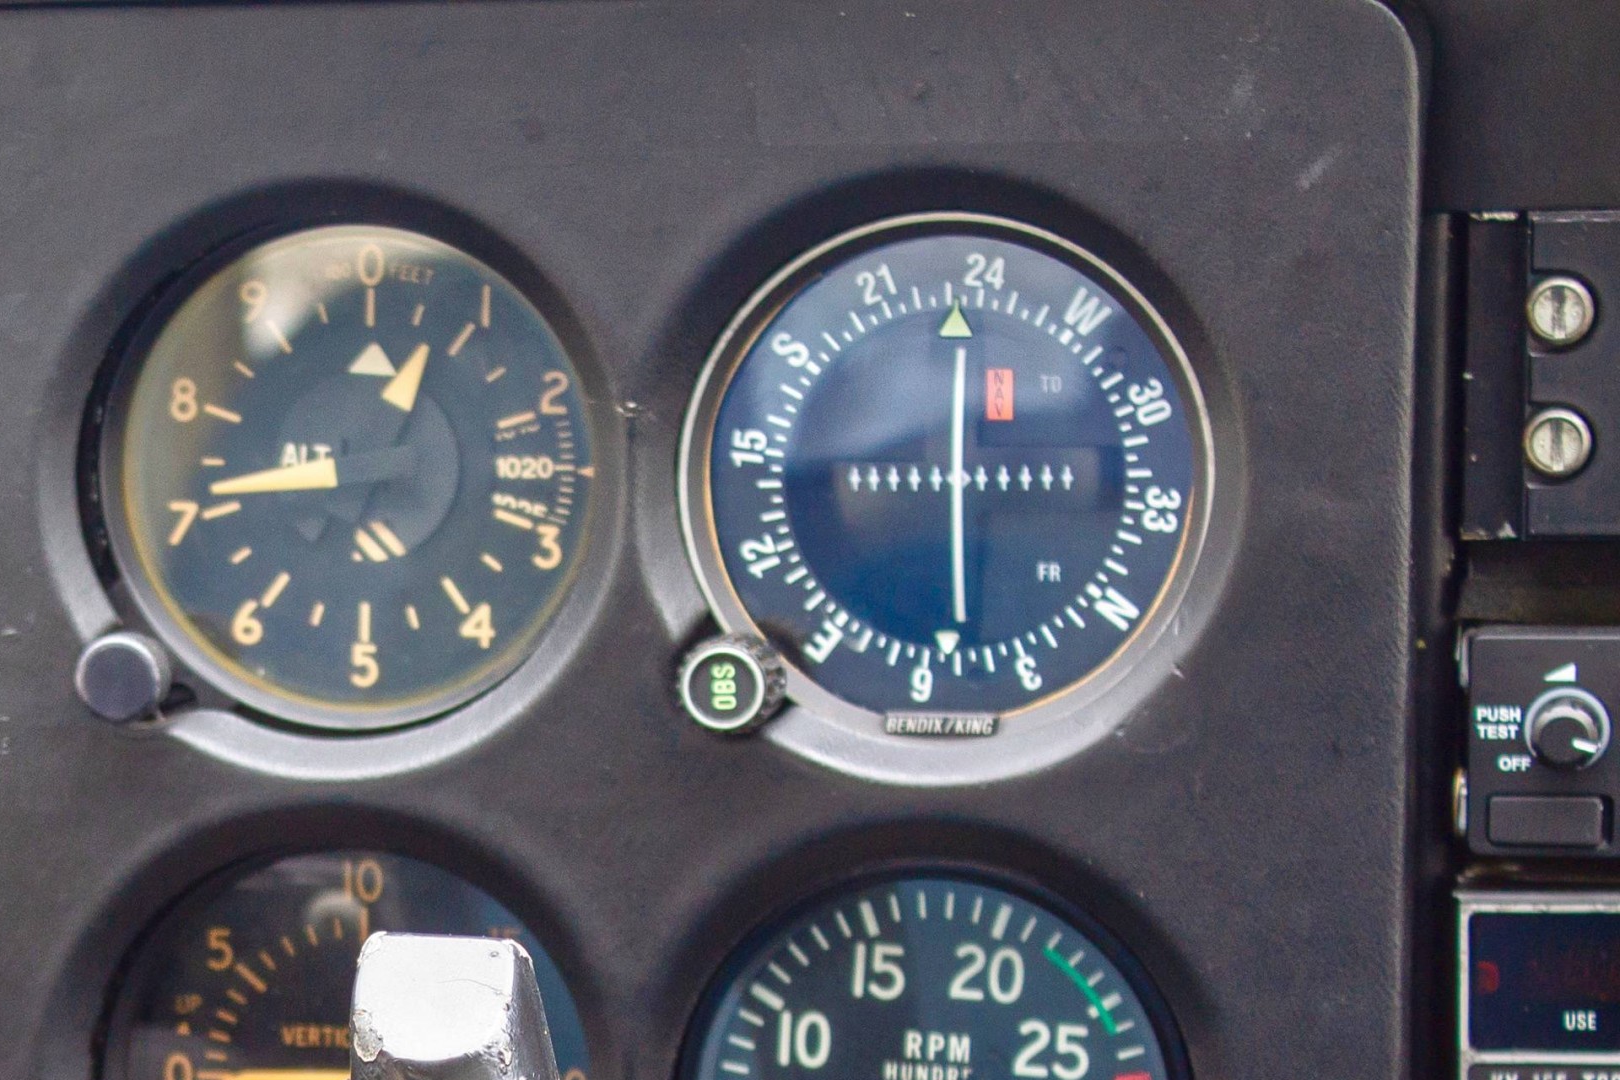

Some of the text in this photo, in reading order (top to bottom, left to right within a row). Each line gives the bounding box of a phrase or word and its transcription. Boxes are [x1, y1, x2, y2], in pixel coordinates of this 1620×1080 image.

[856, 263, 898, 303] 21
[965, 253, 1005, 291] 24
[241, 280, 268, 320] 9
[1065, 287, 1112, 337] W
[772, 333, 810, 370] S
[169, 377, 198, 422] 8
[539, 370, 570, 416] 2
[1128, 378, 1172, 427] 30
[495, 455, 555, 480] 1020
[730, 428, 768, 467] 15
[168, 501, 199, 546] 7
[1141, 485, 1181, 534] 33
[533, 525, 563, 571] 3
[739, 533, 782, 580] 12
[1037, 562, 1062, 583] FR
[232, 600, 262, 645] 6
[460, 603, 495, 649] 4
[1095, 586, 1140, 632] N
[803, 621, 844, 664] E
[350, 644, 380, 688] 5
[711, 663, 736, 711] OBS
[1016, 654, 1042, 691] 3
[1476, 706, 1522, 723] PUSH
[1477, 724, 1519, 740] TEST
[1498, 755, 1531, 773] OFF
[342, 859, 383, 902] 10
[206, 927, 234, 972] 5
[852, 941, 906, 1000] 15
[949, 943, 1025, 1004] 20
[282, 1024, 351, 1049] VERTIC
[777, 1008, 832, 1069] 10
[1564, 1010, 1597, 1032] USE
[904, 1031, 972, 1063] RPM
[1013, 1020, 1090, 1080] 25
